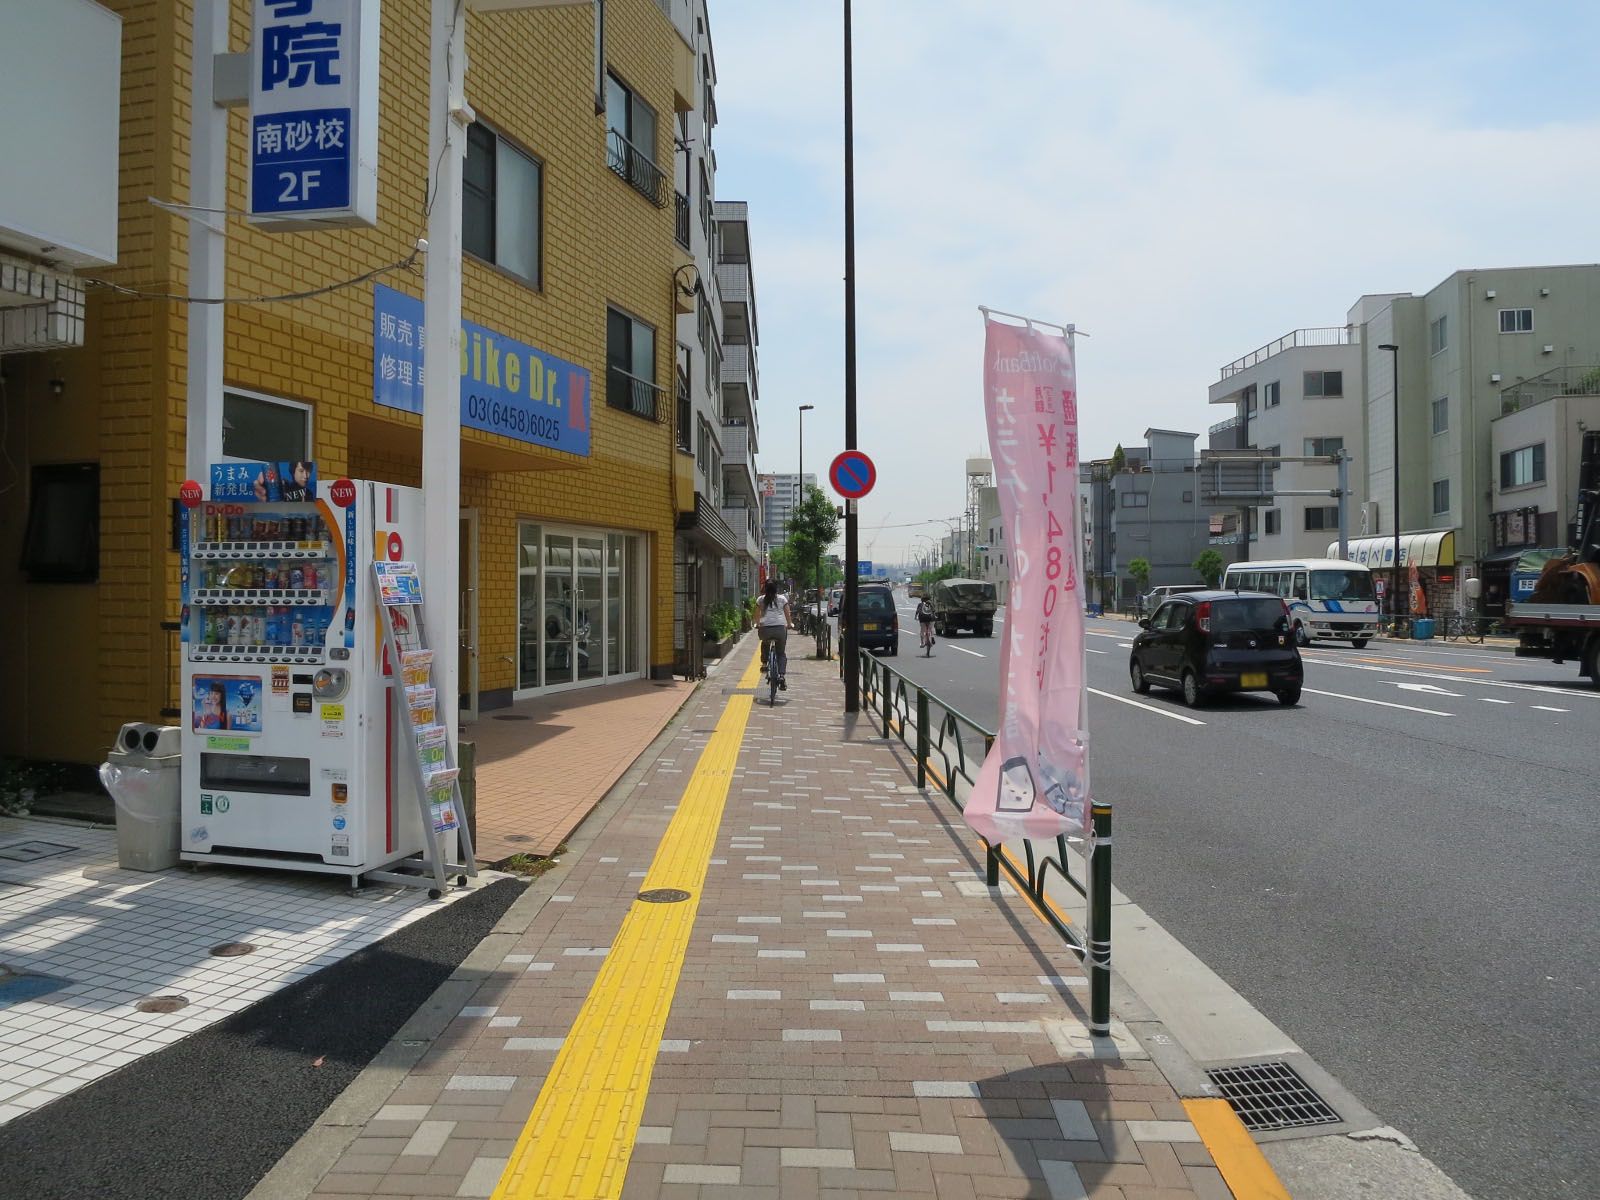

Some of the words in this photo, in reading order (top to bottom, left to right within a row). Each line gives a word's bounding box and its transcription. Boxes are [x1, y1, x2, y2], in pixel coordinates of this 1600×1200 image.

[256, 118, 345, 155] 南砂校
[278, 170, 321, 203] 2F
[380, 311, 413, 347] 販売
[380, 352, 413, 387] 修理
[529, 354, 562, 408] Dr.
[568, 370, 587, 433] K
[468, 394, 560, 442] 03(6458)6025
[214, 466, 250, 482] うまみ
[181, 489, 201, 499] NEW
[286, 488, 308, 501] NEW
[332, 487, 354, 499] NEW
